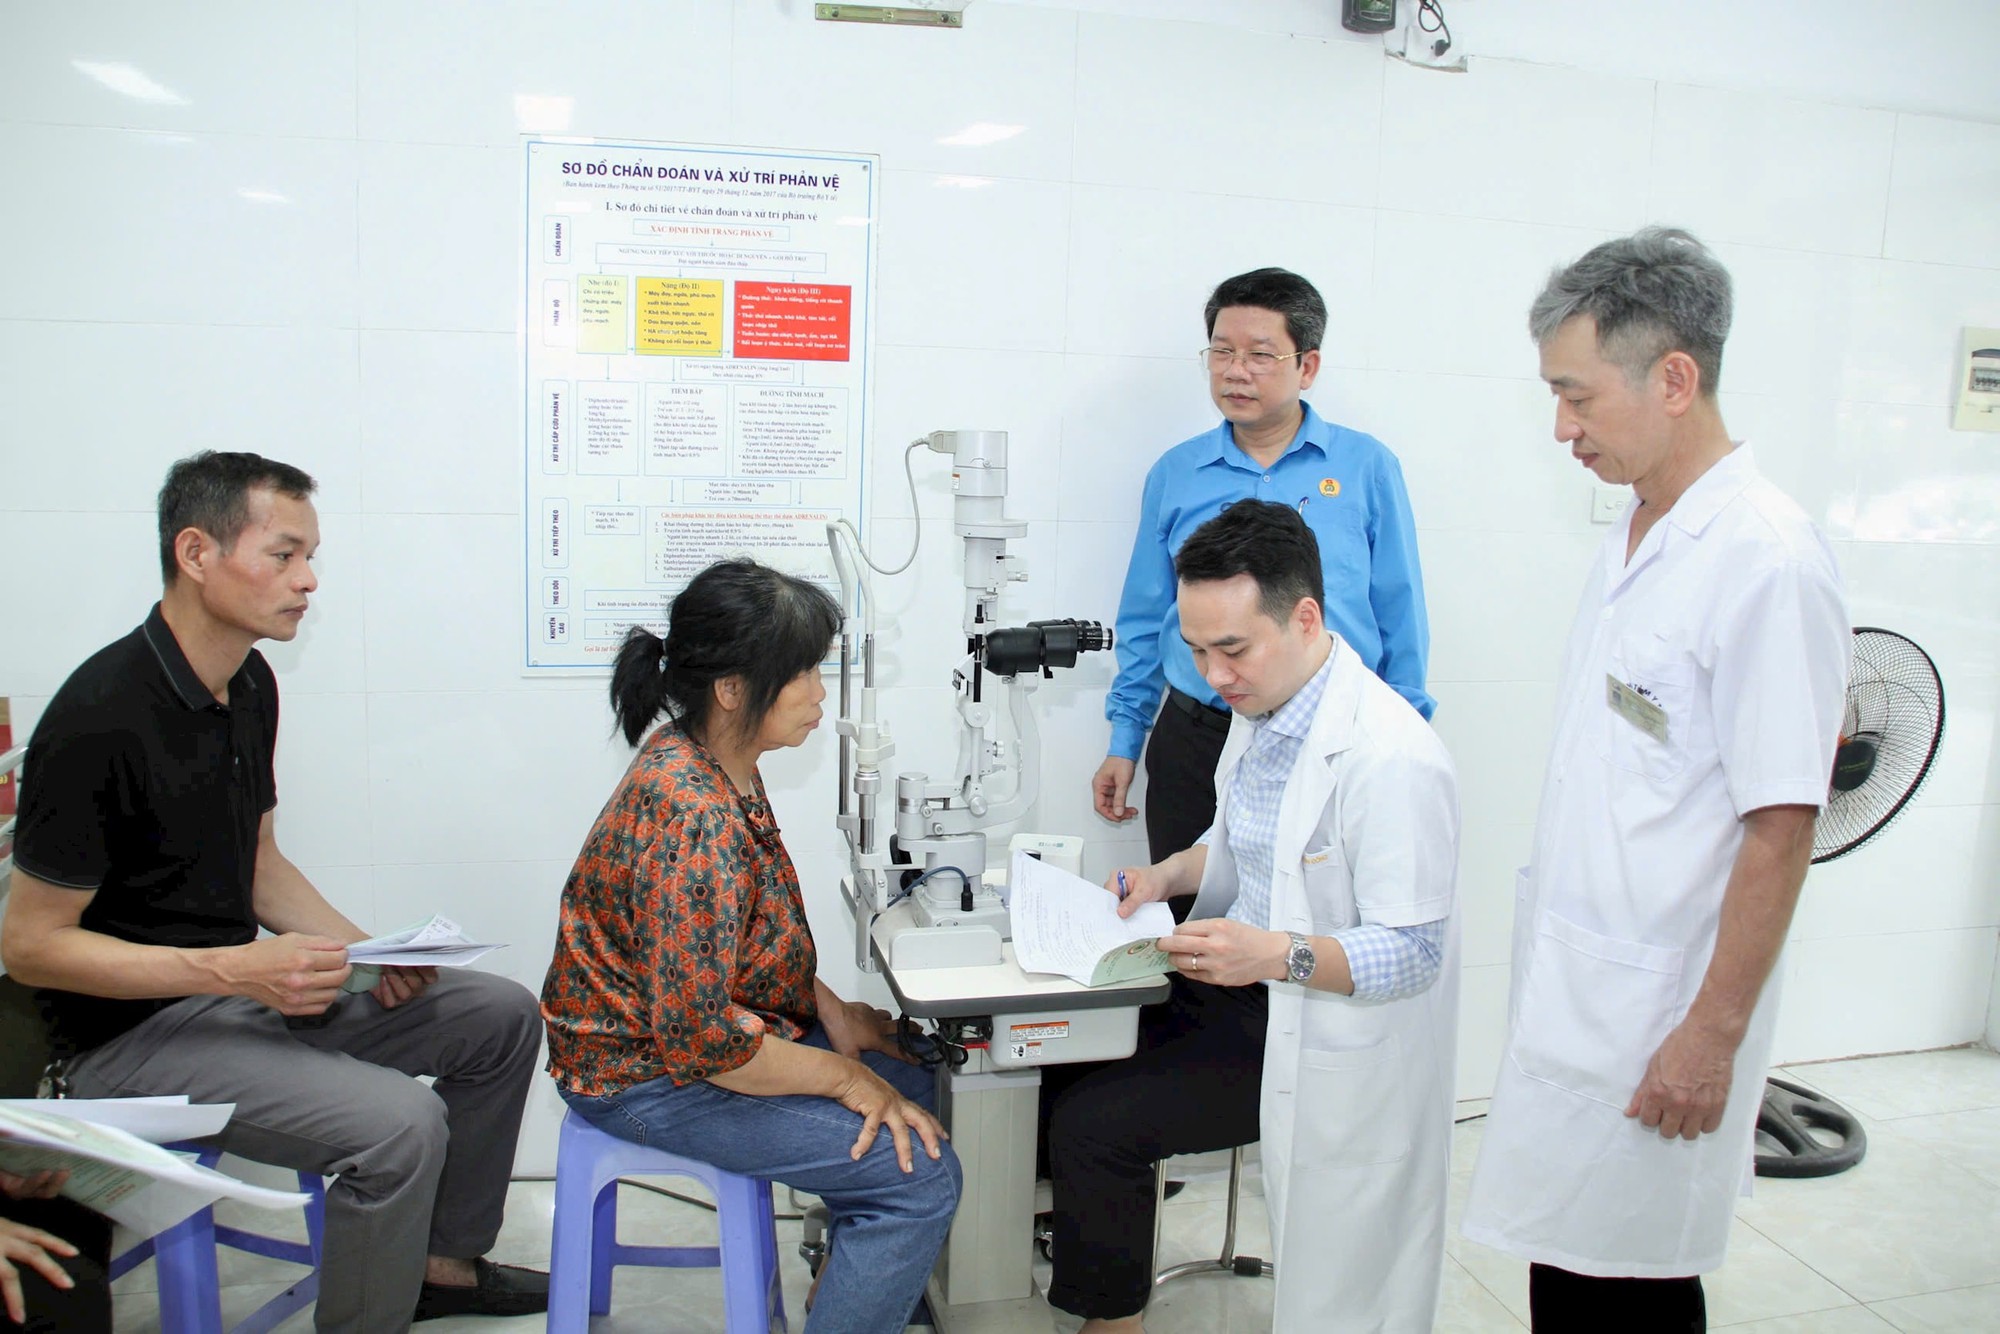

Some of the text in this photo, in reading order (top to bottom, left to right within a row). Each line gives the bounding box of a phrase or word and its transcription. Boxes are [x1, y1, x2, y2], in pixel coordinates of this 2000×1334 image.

[562, 158, 839, 192] SƠ ĐỒ CHẨN ĐOÁN VÀ XỬ TRÍ PHẢN VỆ
[606, 202, 612, 210] I.
[615, 202, 628, 211] Sơ
[644, 204, 658, 213] chi
[660, 204, 676, 214] tiết
[716, 207, 739, 216] đoán
[742, 208, 752, 218] và
[768, 210, 780, 219] trí
